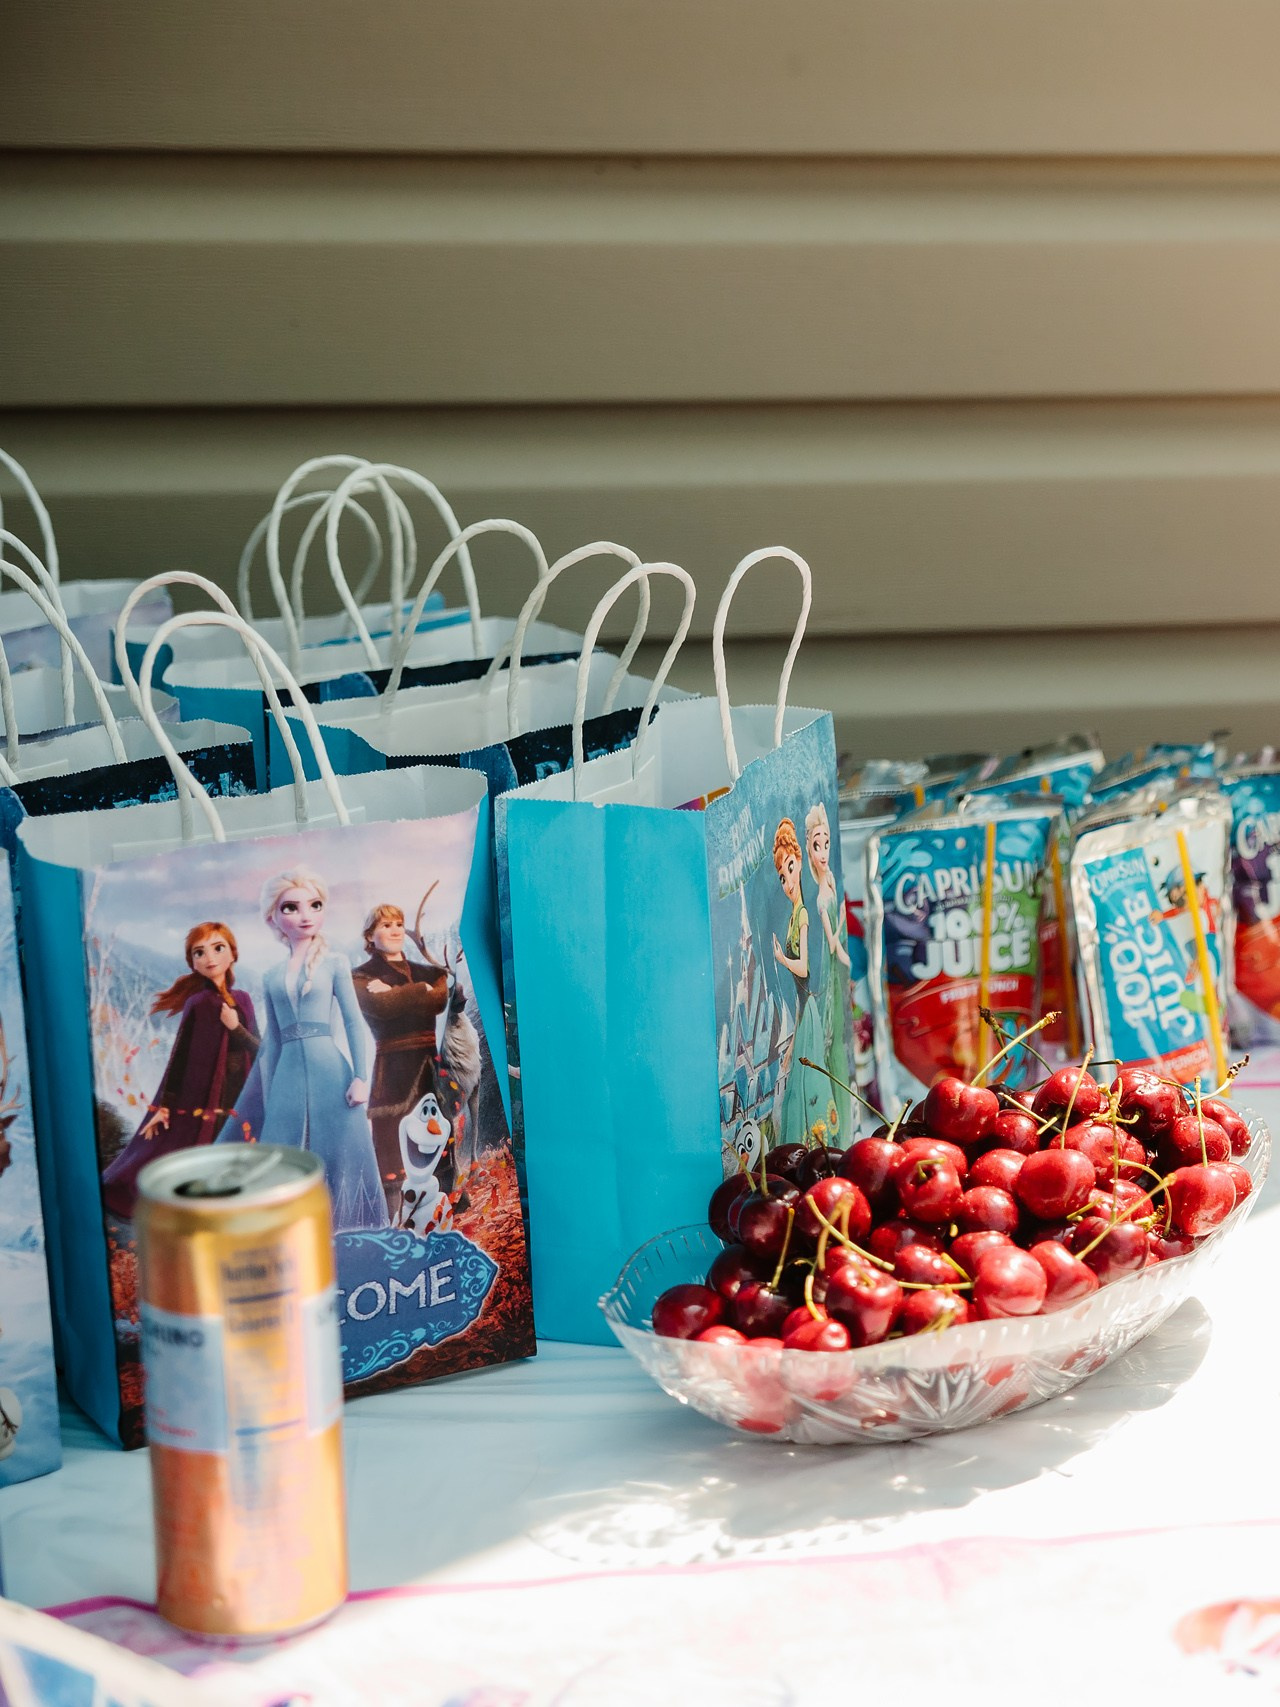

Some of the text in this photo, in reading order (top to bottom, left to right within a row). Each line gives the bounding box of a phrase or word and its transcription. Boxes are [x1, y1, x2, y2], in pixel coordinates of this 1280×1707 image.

[718, 823, 767, 900] BIRTHDAY
[910, 929, 1032, 980] JUICE
[929, 900, 1027, 942] 100%
[987, 979, 1020, 994] UNCH
[1103, 913, 1159, 1029] 100%
[1122, 889, 1195, 1038] JUICE
[338, 1258, 457, 1327] OME
